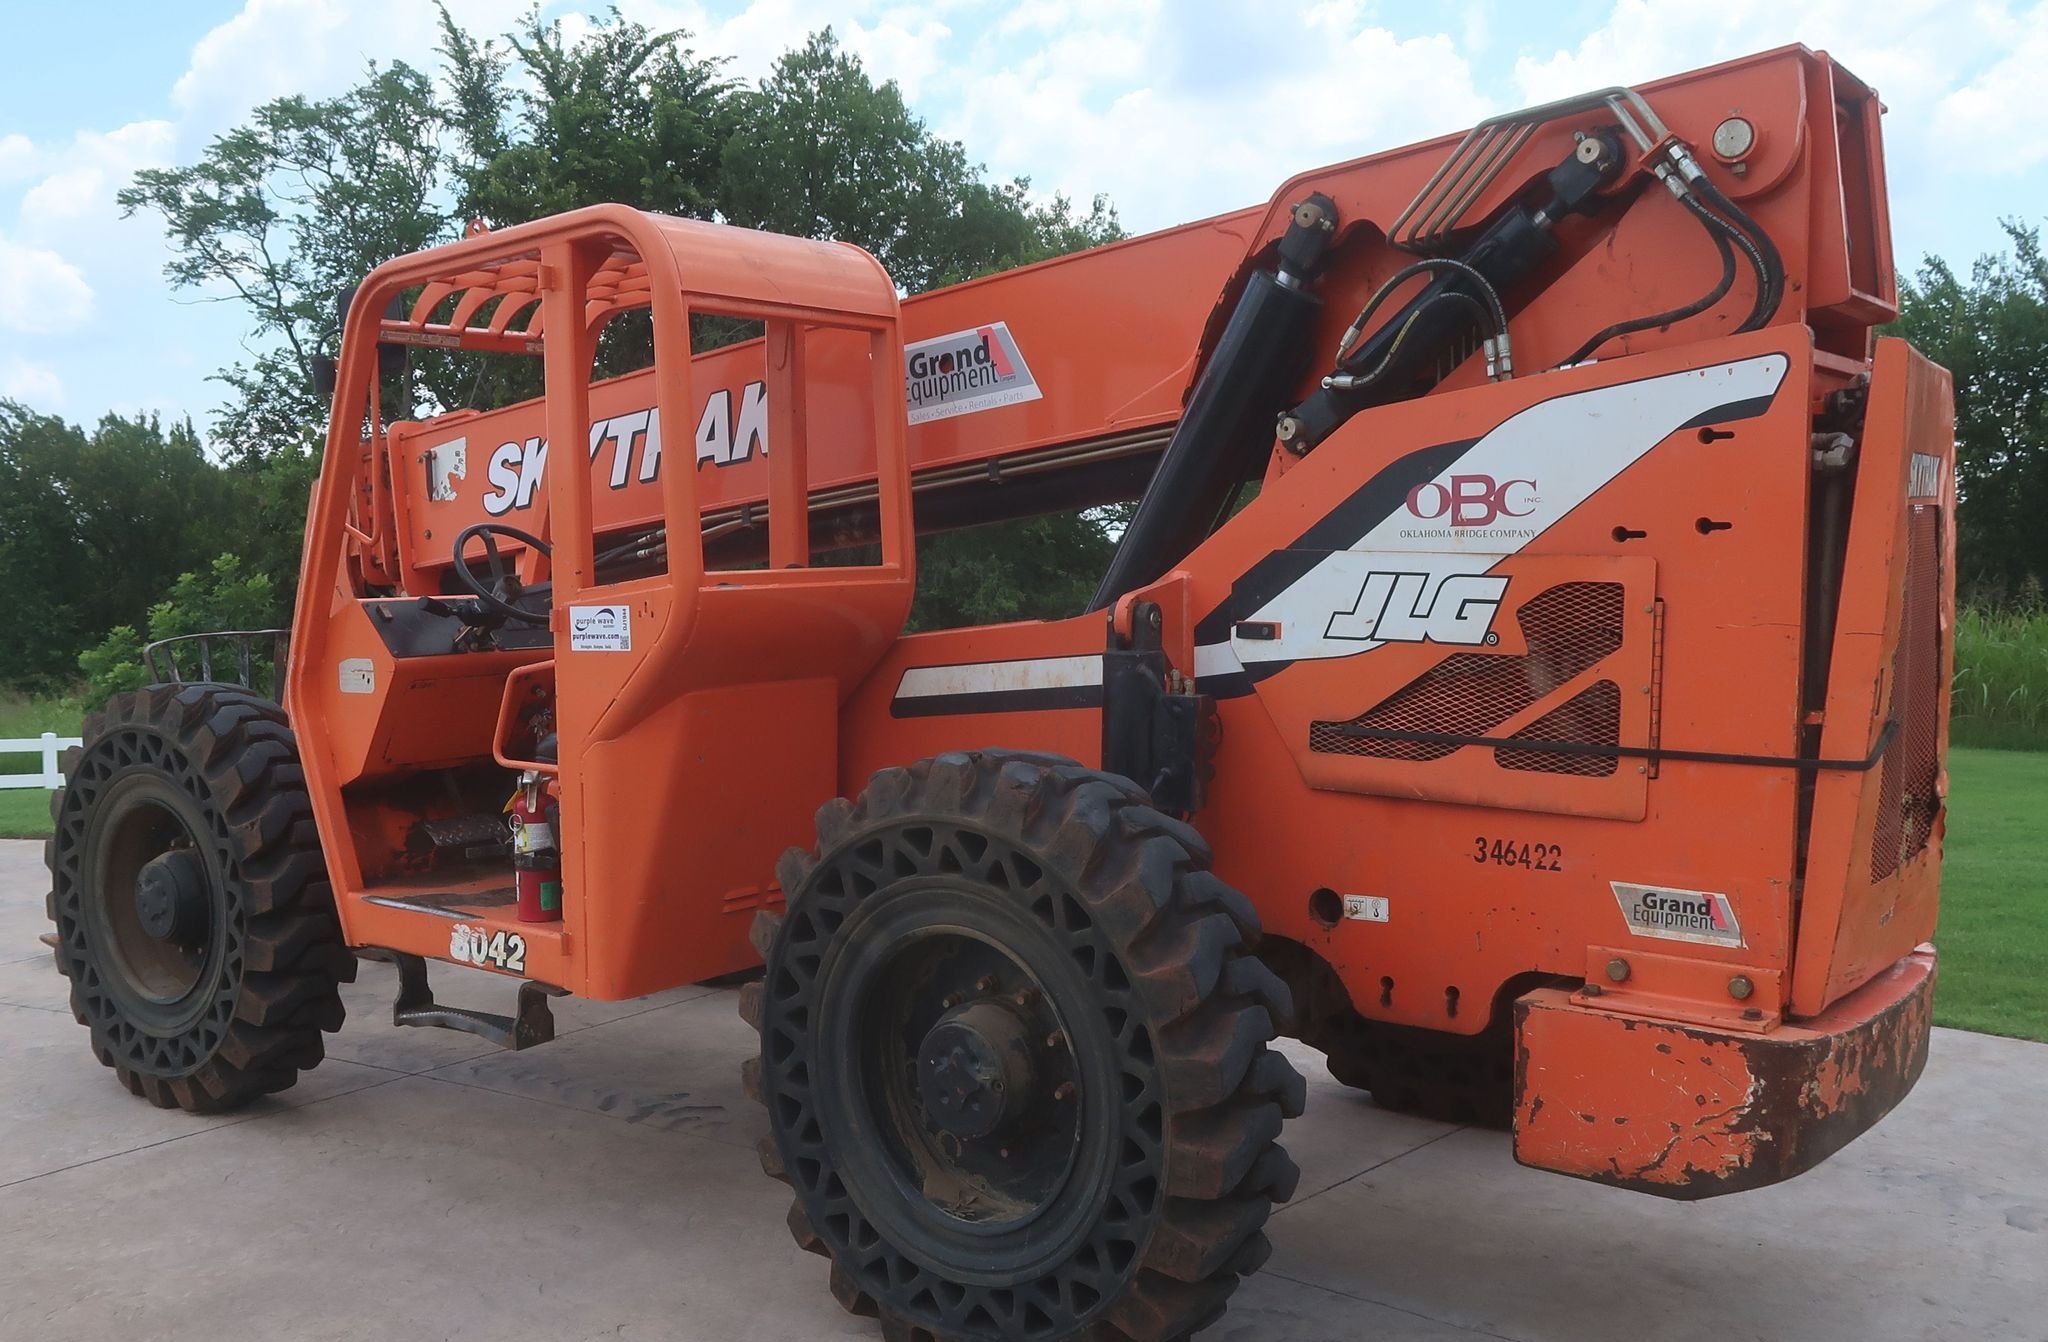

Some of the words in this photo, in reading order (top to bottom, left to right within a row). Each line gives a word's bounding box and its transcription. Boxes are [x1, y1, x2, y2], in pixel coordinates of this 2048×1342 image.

[910, 411, 931, 424] Sales
[936, 404, 963, 418] Service
[969, 395, 998, 411] Rentals
[1003, 391, 1024, 405] Parts
[1406, 474, 1537, 527] OBC
[1400, 529, 1452, 539] OKLAHOMA
[1454, 529, 1488, 538] BRIDGE
[1489, 529, 1537, 538] COMPANY
[1323, 571, 1512, 646] JLG
[1473, 837, 1562, 872] 346422
[1633, 904, 1716, 930] Equipment
[1641, 892, 1712, 916] Grand
